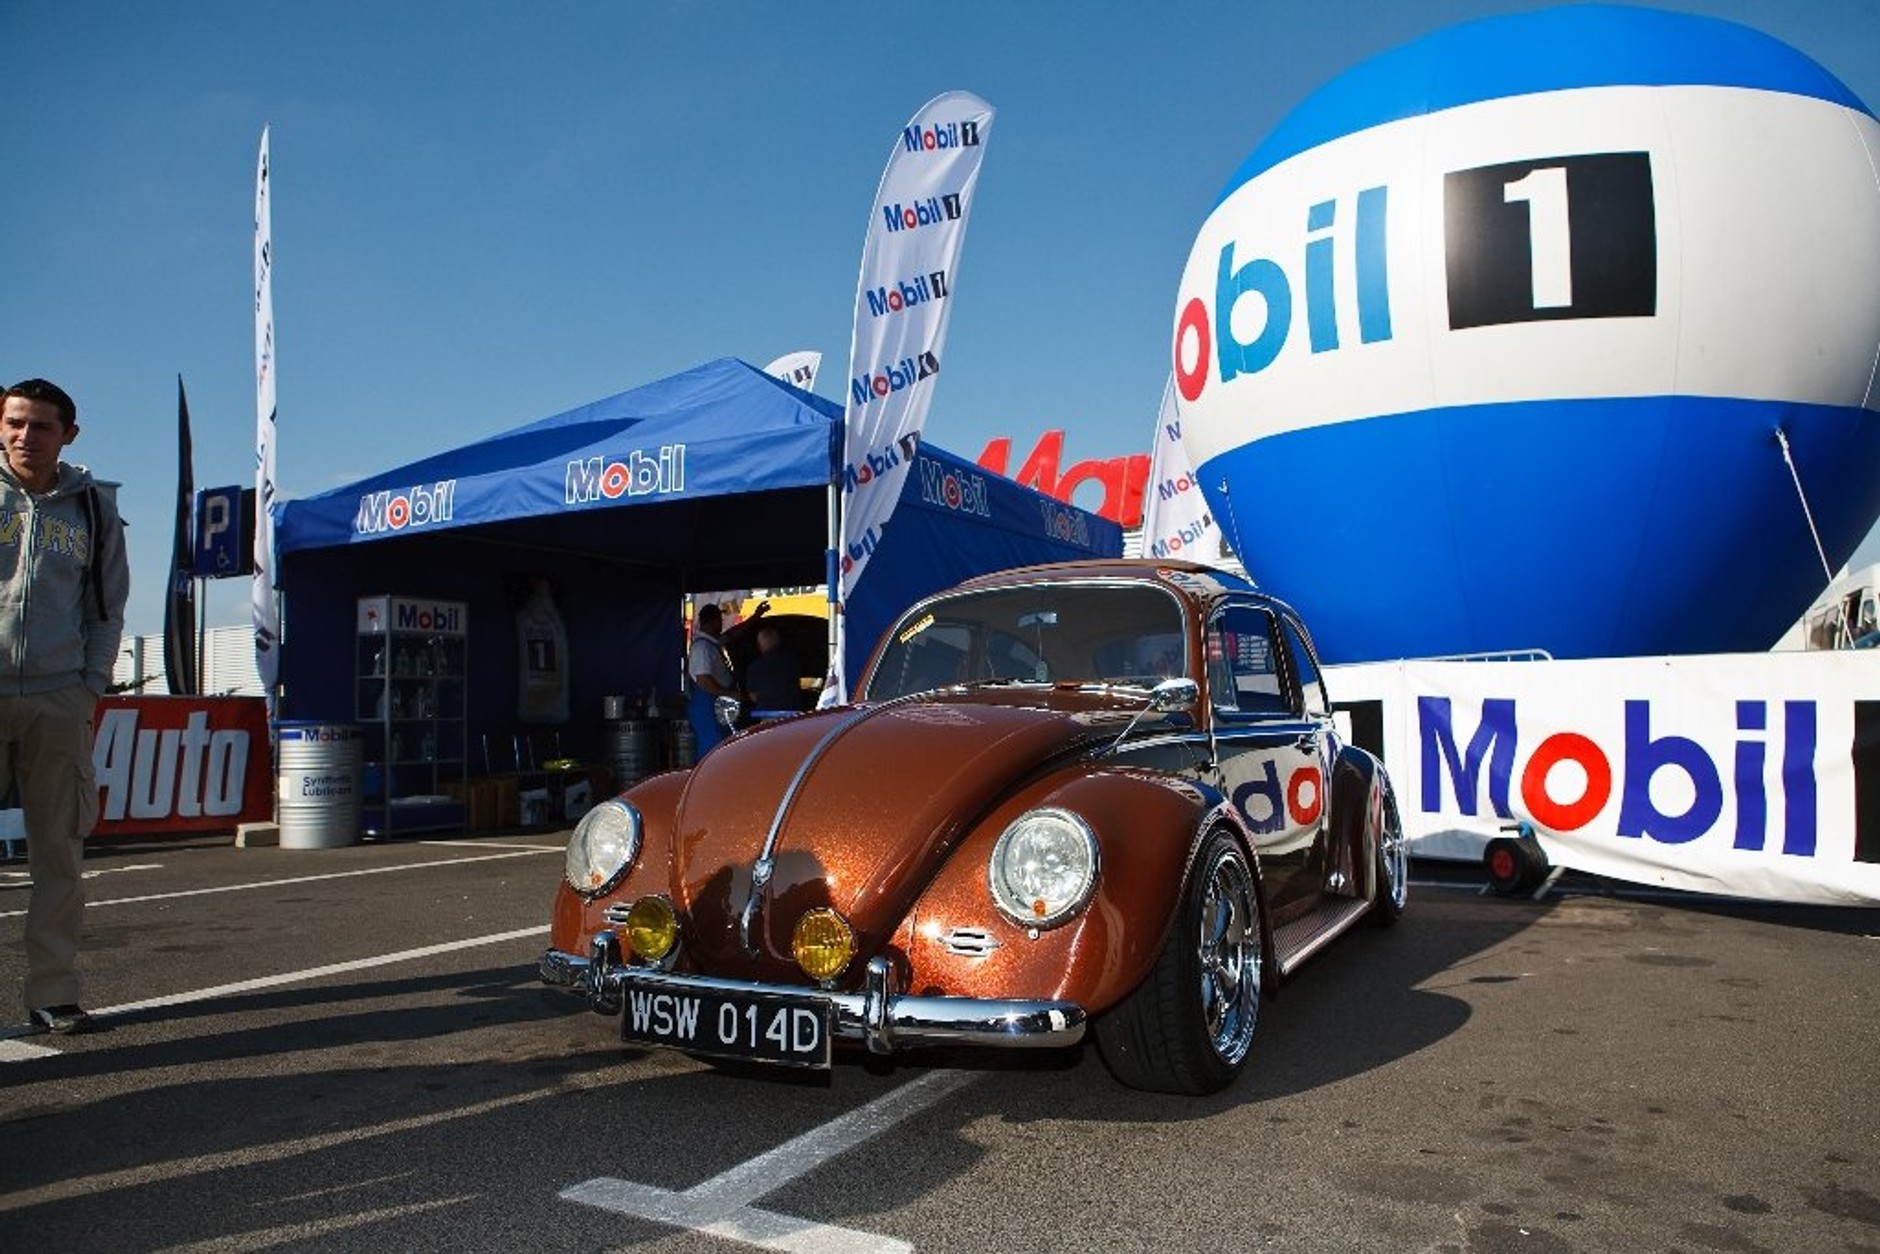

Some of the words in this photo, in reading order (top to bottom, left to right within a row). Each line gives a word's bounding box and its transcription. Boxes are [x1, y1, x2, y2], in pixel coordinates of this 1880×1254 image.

[904, 123, 958, 152] Mobil
[963, 122, 978, 146] 1
[883, 197, 942, 232] Mobil
[944, 194, 960, 220] 1
[1504, 167, 1572, 309] 1
[866, 276, 929, 317] Mobil
[931, 272, 947, 298] 1
[852, 358, 917, 407] Mobil
[565, 445, 686, 504] Mobil
[919, 456, 991, 518] Mobil
[203, 495, 230, 551] P
[357, 480, 456, 533] Mobil
[1039, 499, 1090, 547] Mobil
[398, 605, 459, 631] Mobil
[304, 729, 349, 743] Mobil
[92, 708, 250, 820] Auto
[1417, 695, 1817, 857] Mobil
[629, 989, 701, 1040] WSW
[718, 1002, 819, 1053] 014D
